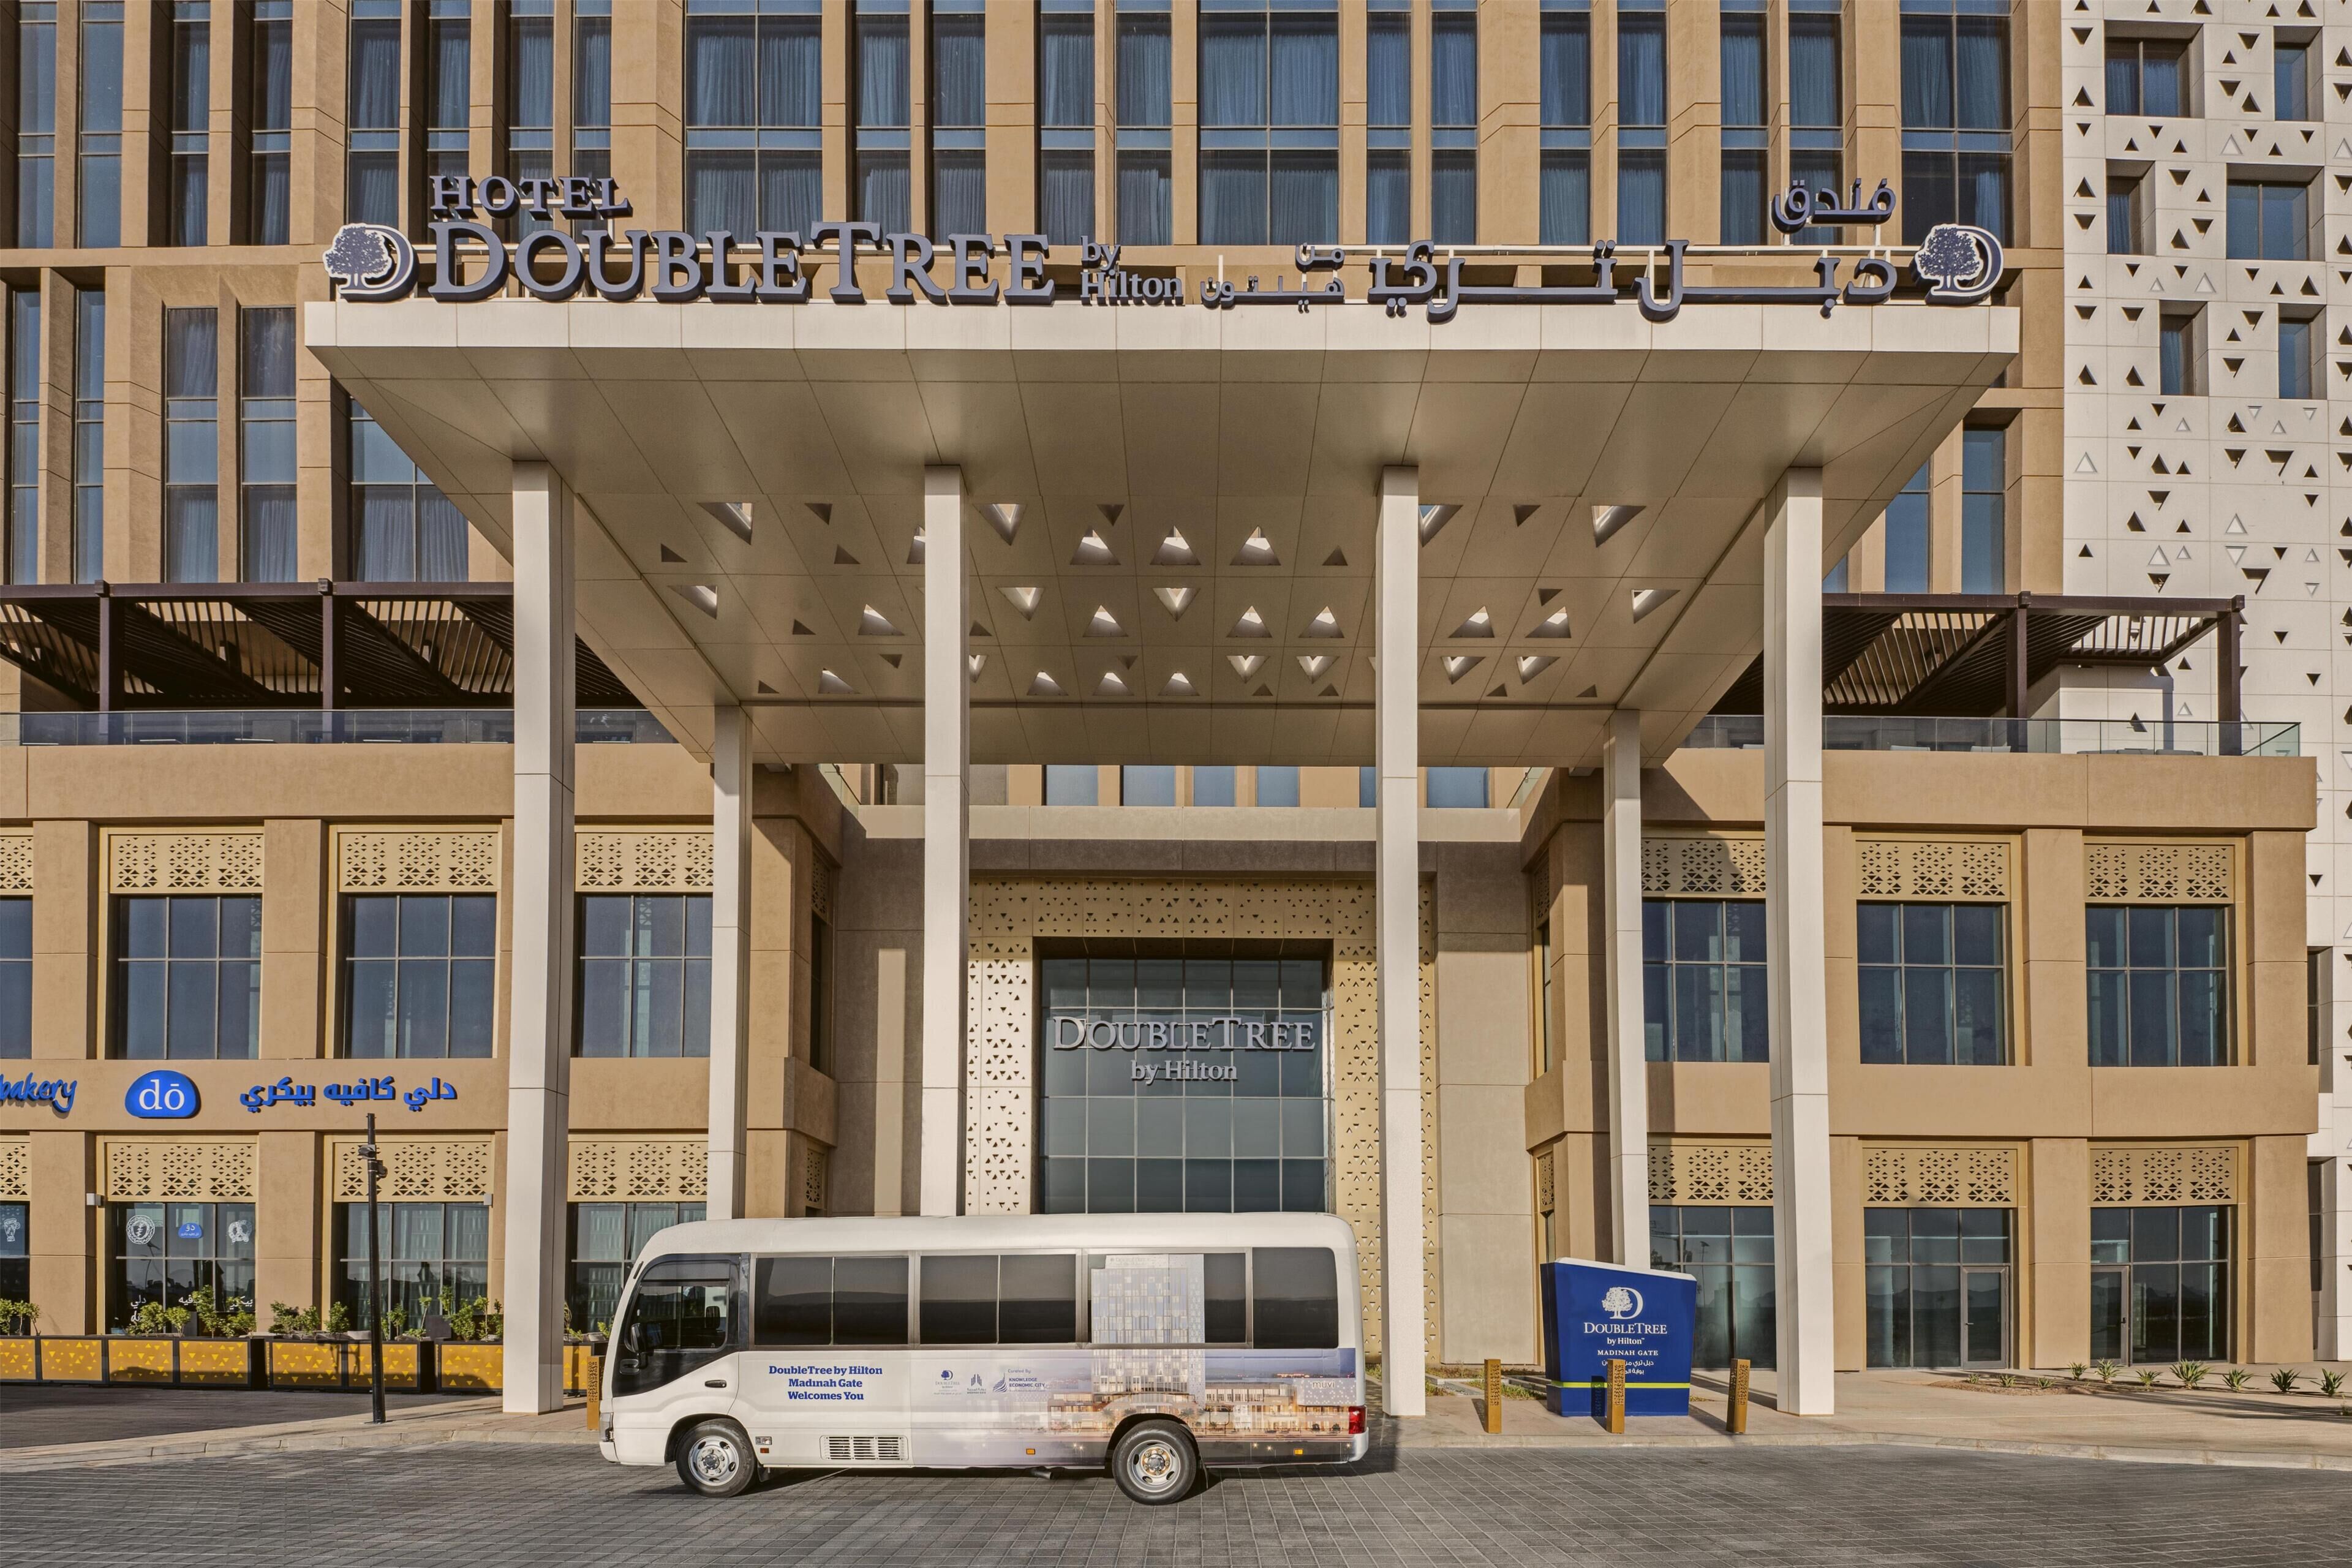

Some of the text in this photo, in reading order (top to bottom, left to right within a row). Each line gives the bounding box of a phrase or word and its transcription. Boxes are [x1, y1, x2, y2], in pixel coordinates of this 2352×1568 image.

[429, 175, 633, 221] HOTEL
[1772, 178, 1897, 234] فندق
[428, 221, 1055, 305] DOUBLETREE
[1080, 235, 1122, 271] by
[1080, 270, 1185, 306] Hilton
[1200, 243, 1345, 314] من هيلتون
[1366, 239, 1898, 324] دبل تري
[1053, 1016, 1316, 1052] DOUBLETREE
[1131, 1060, 1238, 1085] by Hilton
[239, 1076, 458, 1114] دلي كافيه بيكري
[1584, 1322, 1668, 1335] DOUBLETREE
[1607, 1337, 1616, 1346] by
[769, 1365, 883, 1376] DoubleTree by Hilton
[838, 1379, 863, 1387] Gate
[788, 1391, 864, 1400] Welcomes You
